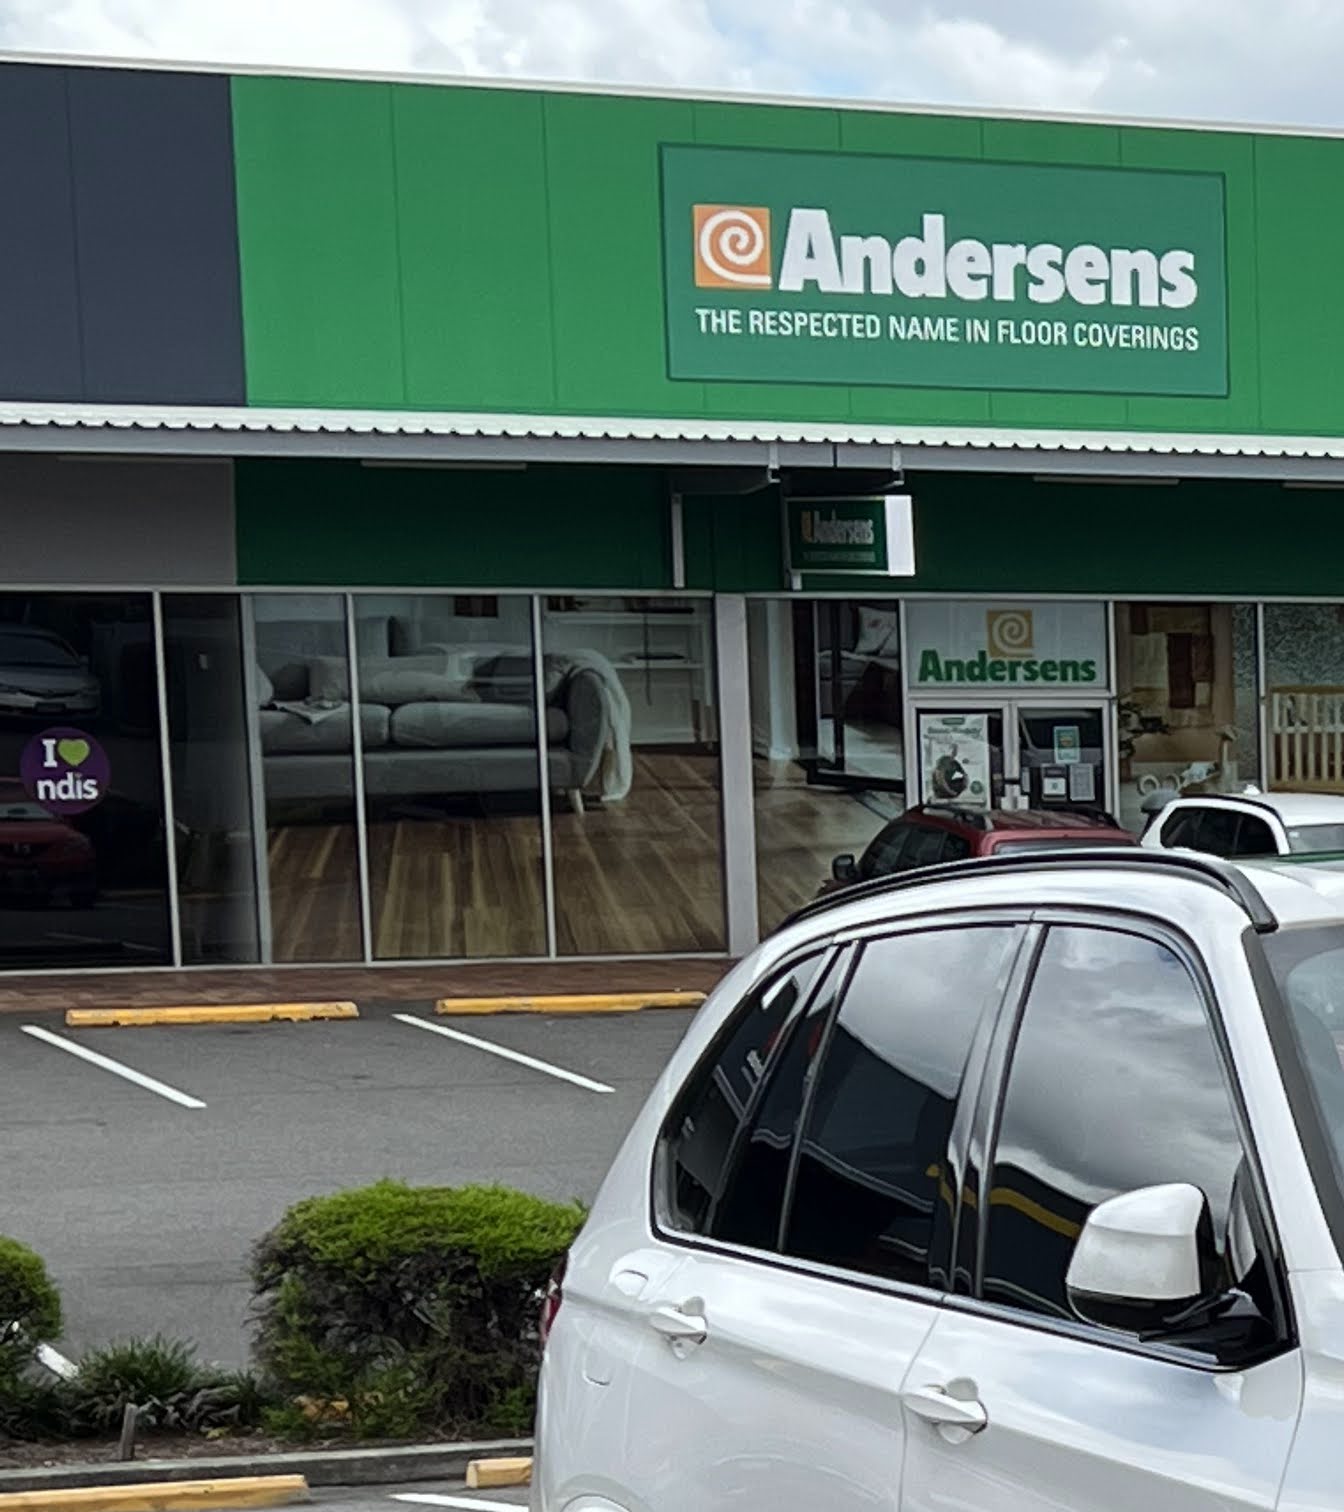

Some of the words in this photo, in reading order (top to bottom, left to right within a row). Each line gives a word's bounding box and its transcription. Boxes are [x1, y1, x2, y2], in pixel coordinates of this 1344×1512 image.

[779, 207, 1198, 309] Andersens
[696, 309, 741, 335] THE
[749, 312, 881, 339] RESPECTED
[889, 317, 959, 342] NAME
[965, 319, 990, 344] IN
[997, 320, 1068, 346] FLOOR
[1074, 323, 1199, 352] COVERINGS
[918, 649, 1097, 682] Andersens
[42, 738, 57, 767] I
[37, 772, 98, 800] ndis
